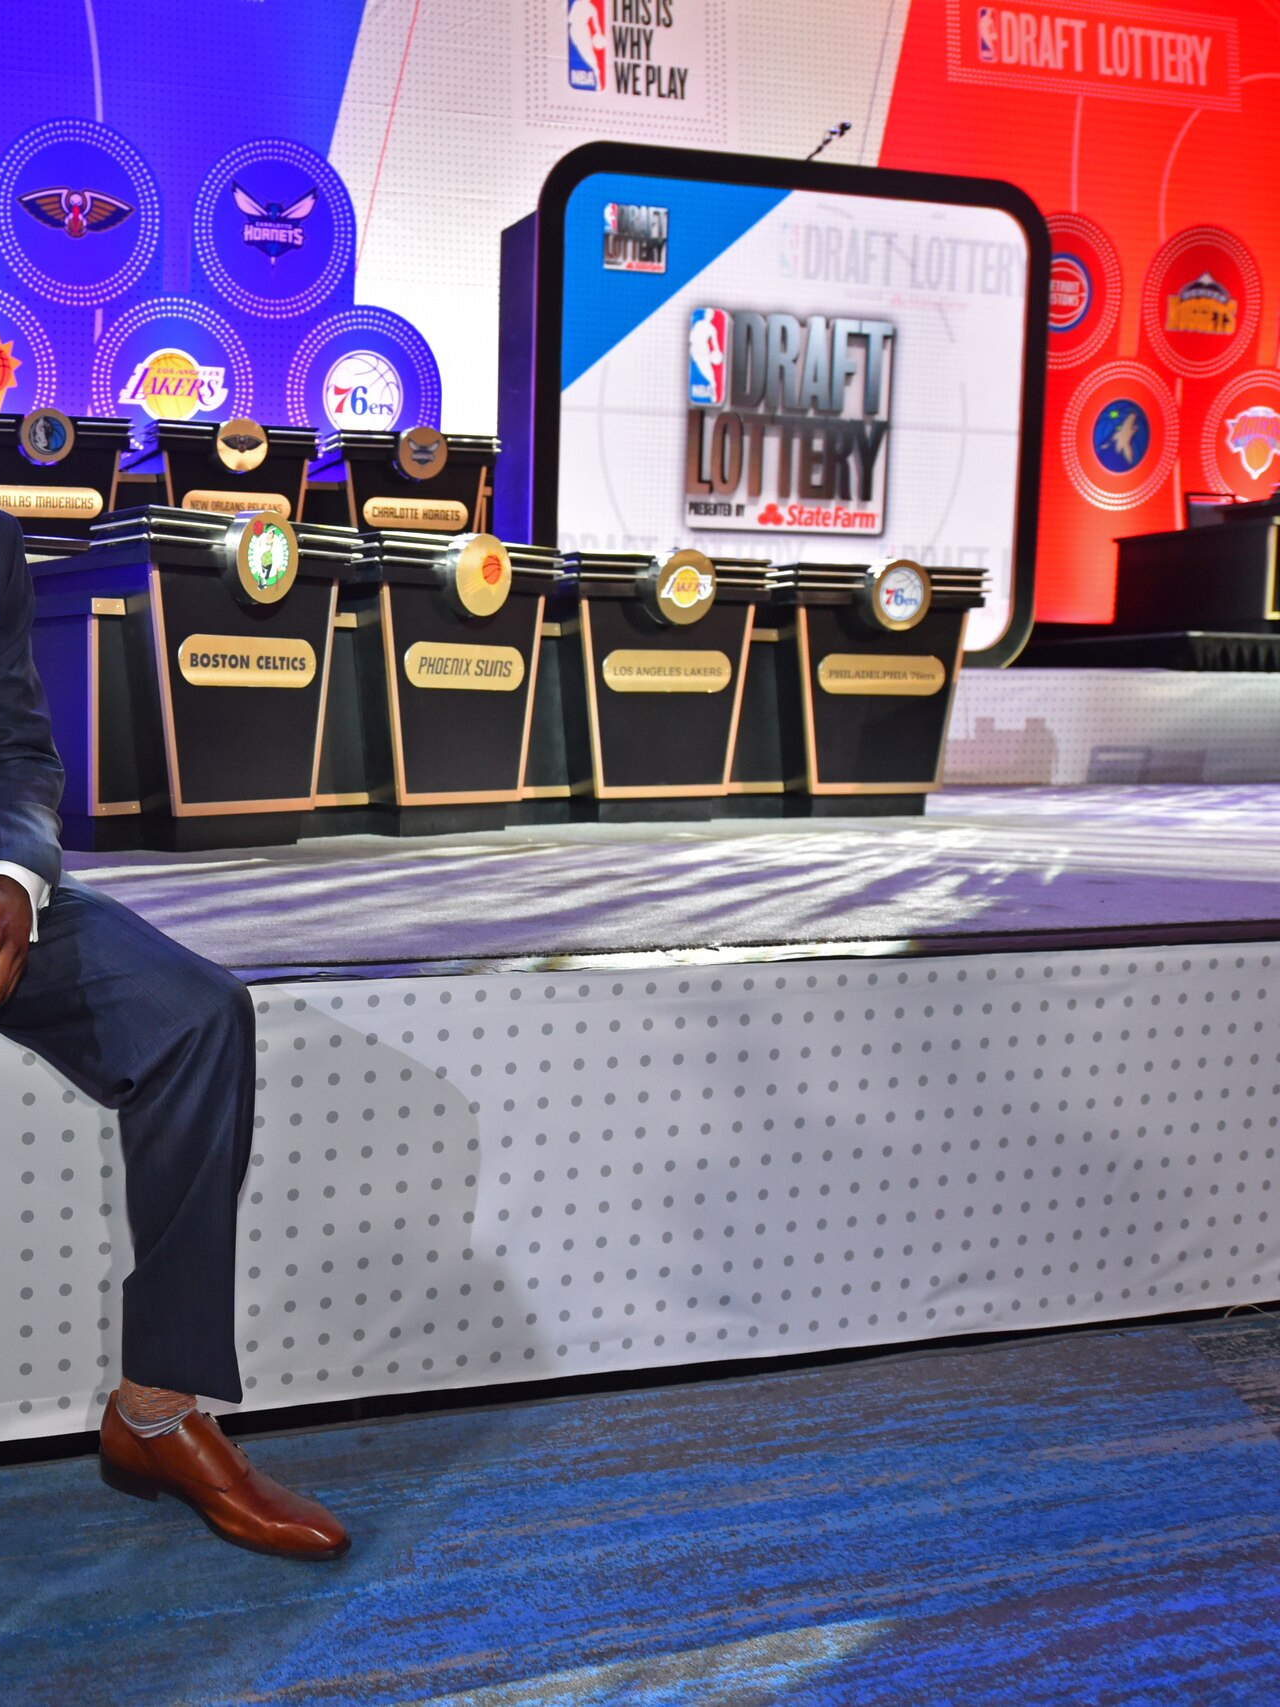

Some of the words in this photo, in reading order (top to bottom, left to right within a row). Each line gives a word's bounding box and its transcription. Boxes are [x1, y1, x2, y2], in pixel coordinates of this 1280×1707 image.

[612, 0, 652, 26] THIS
[656, 0, 674, 28] IS
[612, 25, 654, 61] WHY
[1000, 10, 1087, 72] DRAFT
[1098, 23, 1212, 86] LOTTERY
[614, 61, 642, 96] WE
[646, 63, 688, 100] PLAY
[243, 224, 304, 246] HORNETS
[803, 224, 898, 288] DRAFT
[731, 310, 895, 416] DRAFT
[129, 366, 220, 407] LAKERS
[332, 384, 394, 416] 76ers
[686, 409, 890, 502] LOTTERY
[35, 495, 94, 510] MAVERICKS
[190, 500, 209, 511] NEW
[211, 501, 245, 511] ORLEANS
[372, 506, 419, 520] CHARLOTTE
[422, 508, 460, 521] HORNETS
[688, 501, 732, 517] PRESENTED
[735, 503, 746, 517] BY
[885, 588, 918, 606] 76ers
[190, 652, 250, 669] BOSTON
[256, 655, 306, 671] CELTICS
[418, 656, 473, 676] PHOENIX
[474, 659, 513, 678] SUNS
[613, 666, 634, 677] LOS
[636, 666, 682, 677] ANGELES
[683, 667, 723, 678] LAKERS
[828, 668, 908, 681] PHILADELPHIA
